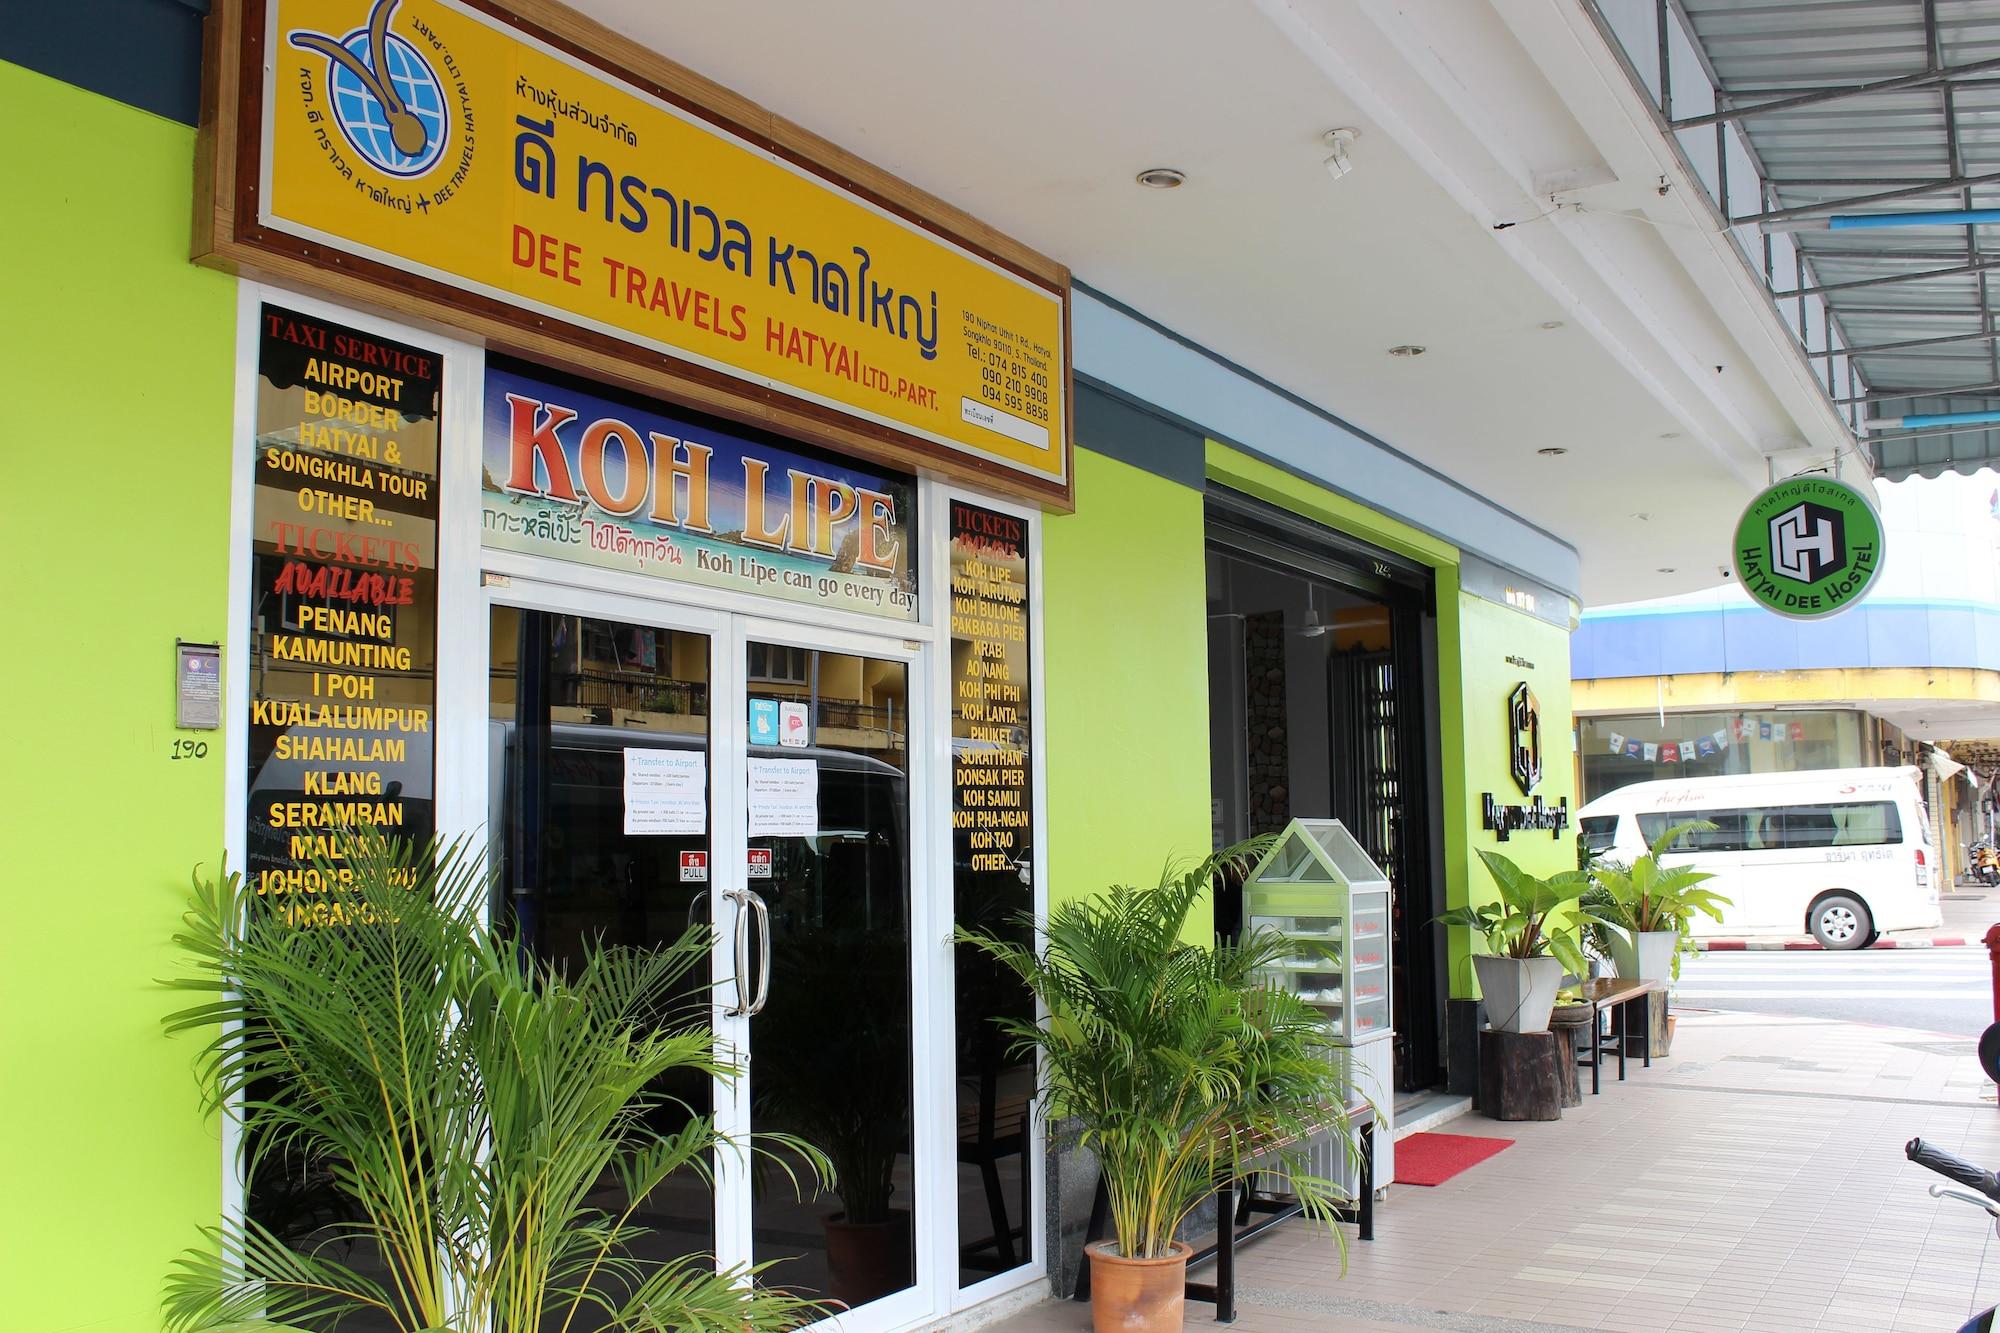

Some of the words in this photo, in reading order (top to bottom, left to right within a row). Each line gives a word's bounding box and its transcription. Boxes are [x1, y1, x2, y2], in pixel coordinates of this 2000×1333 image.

[456, 82, 474, 132] HATYAI
[516, 76, 637, 148] ห้างหุ้นส่วนจำกัด
[314, 127, 353, 181] ทราเวล
[356, 178, 412, 214] หาดใหญ่
[451, 136, 475, 190] TRAVELS
[434, 187, 454, 206] DEE
[514, 114, 556, 199] ดี
[578, 154, 752, 278] ทราเวล
[768, 234, 938, 361] หาดใหญ่
[512, 223, 582, 286] DEE
[603, 256, 747, 342] TRAVELS
[766, 316, 858, 383] HATYAI
[962, 310, 974, 324] 190
[266, 315, 326, 351] TAXI
[334, 335, 432, 380] SERVICE
[304, 358, 404, 402] AIRPORT
[988, 353, 1006, 370] 074
[1012, 362, 1026, 380] 815
[1031, 372, 1048, 388] 400
[982, 367, 1002, 386] 090
[1006, 376, 1021, 394] 210
[1025, 384, 1048, 404] 9908
[304, 390, 400, 432] BORDER
[982, 384, 1000, 402] 094
[1005, 394, 1022, 411] 595
[1026, 402, 1048, 422] 8858
[300, 422, 378, 460] HATYAI
[384, 440, 401, 464] &
[266, 448, 374, 490] SONGKHLA
[378, 472, 428, 501] TOUR
[502, 392, 714, 535] KOH
[740, 456, 899, 575] LIPE
[298, 488, 392, 527] OTHER...
[483, 508, 582, 546] กาะหลีเป๊ะ
[955, 506, 1020, 540] TICKETS
[271, 520, 420, 573] TICKETS
[697, 548, 733, 575] Koh
[740, 557, 776, 588] Lipe
[784, 570, 812, 591] can
[818, 577, 838, 597] go
[844, 584, 884, 608] every
[889, 587, 914, 612] day
[966, 560, 986, 580] KOH
[990, 566, 1011, 584] LIPE
[1742, 547, 1782, 601] HATYAI
[1784, 594, 1822, 608] DEE
[1824, 542, 1872, 603] HOSTEL
[954, 576, 976, 596] KOH
[978, 582, 1022, 604] TARUTAO
[298, 604, 392, 638] PENANG
[956, 596, 976, 616] KOH
[980, 601, 1020, 622] BULONE
[952, 616, 1000, 638] PAKBARA
[1003, 624, 1024, 642] PIER
[272, 634, 411, 671] KAMUNTING
[974, 639, 1005, 658] KRABI
[966, 660, 980, 677] AO
[982, 662, 1009, 680] NANG
[313, 672, 320, 696] I
[328, 674, 375, 700] POH
[960, 680, 980, 698] KOH
[984, 683, 1000, 700] PHI
[1004, 686, 1020, 702] PHI
[252, 700, 428, 733] KUALALUMPUR
[962, 703, 983, 721] KOH
[986, 706, 1017, 724] LANTA
[172, 738, 208, 760] 190
[275, 735, 406, 762] SHAHALAM
[970, 726, 1011, 744] PHUKET
[638, 758, 666, 766] Transfer
[675, 760, 697, 768] Airport
[759, 766, 782, 774] Transfer
[791, 767, 810, 776] Airport
[961, 748, 1022, 766] SURATTHANI
[304, 771, 382, 796] KLANG
[956, 768, 1000, 786] DONSAK
[1002, 770, 1024, 786] PIER
[964, 790, 984, 806] KOH
[988, 790, 1020, 807] SAMUI
[269, 802, 403, 828] SERAMBAN
[952, 811, 974, 828] KOH
[978, 810, 1028, 828] PHA-NGAN
[970, 832, 992, 848] KOH
[994, 832, 1013, 848] TAO
[684, 868, 704, 878] PULL
[749, 864, 768, 874] PUSH
